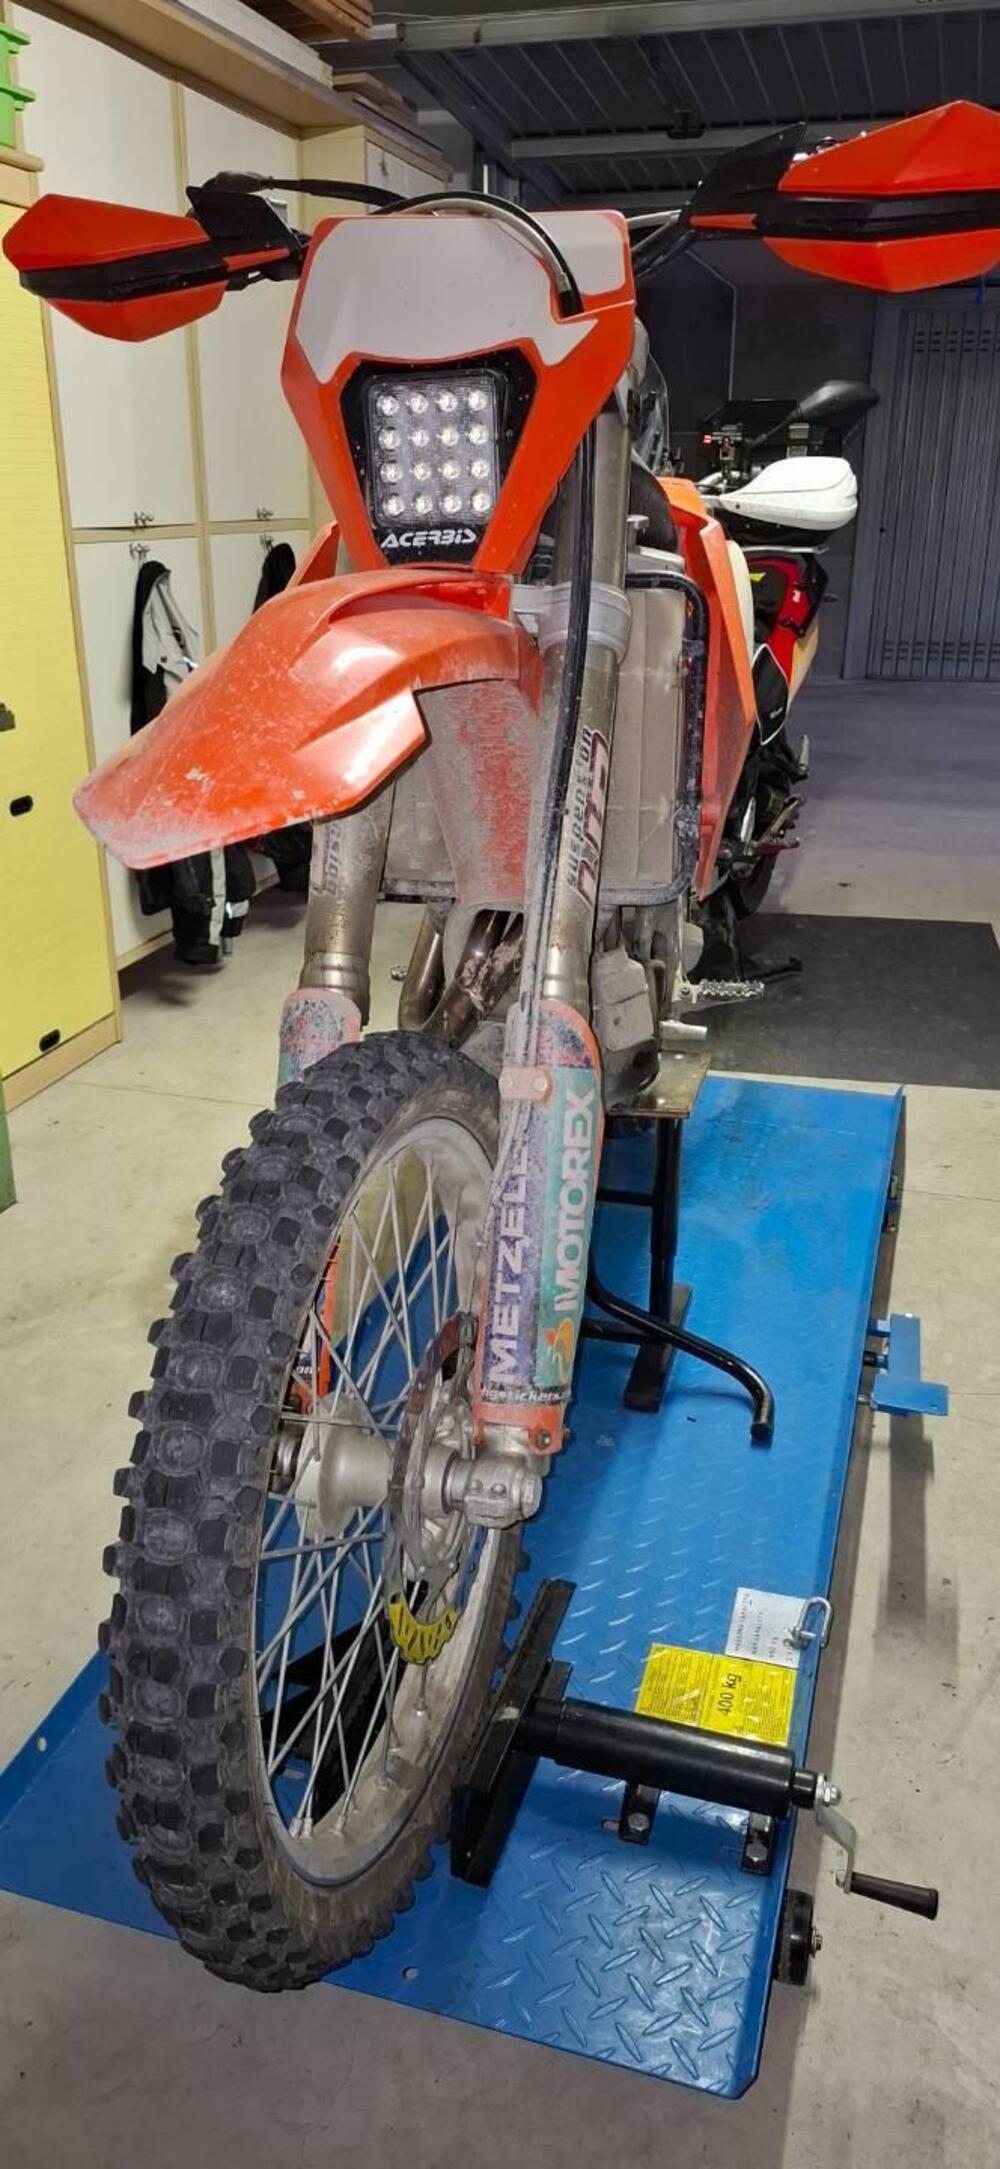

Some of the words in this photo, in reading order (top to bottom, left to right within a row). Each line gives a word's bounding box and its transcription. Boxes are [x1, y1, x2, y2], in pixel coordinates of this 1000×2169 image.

[380, 528, 476, 549] ACERBIS
[554, 1087, 595, 1313] MOTOREX
[723, 1672, 742, 1691] kg
[716, 1690, 733, 1716] 400
